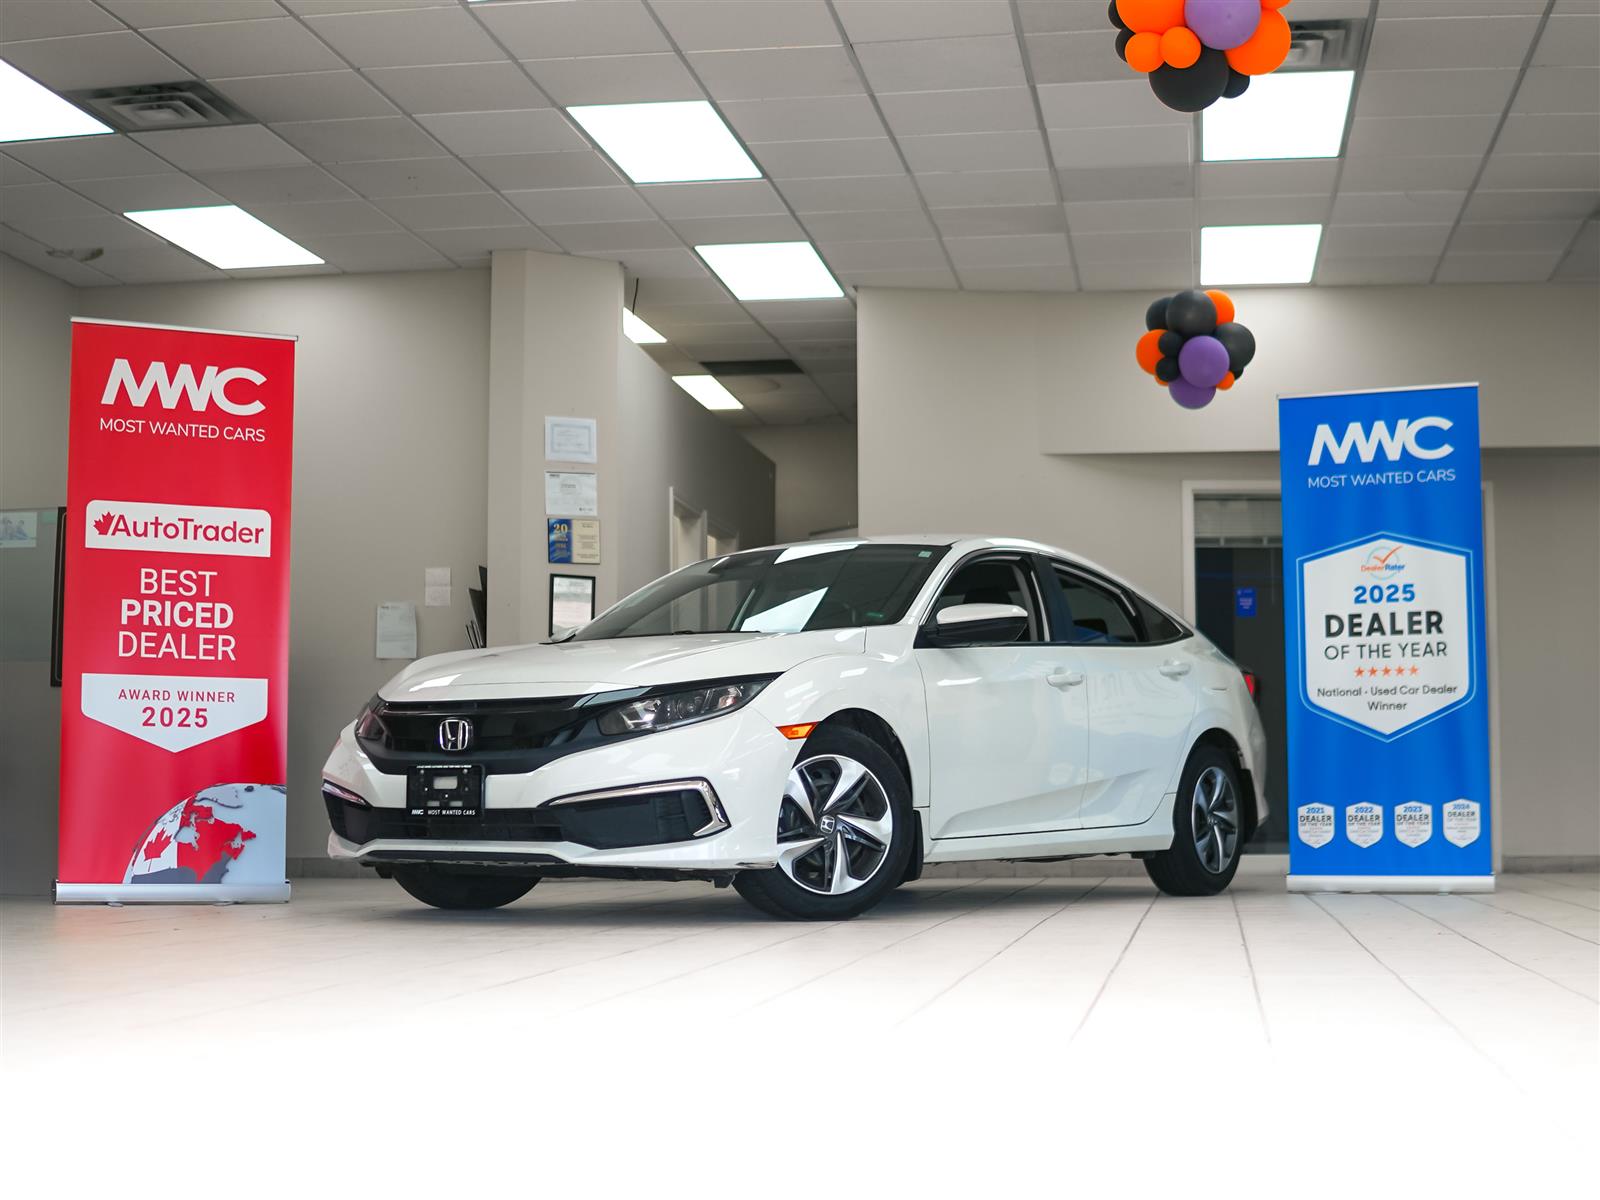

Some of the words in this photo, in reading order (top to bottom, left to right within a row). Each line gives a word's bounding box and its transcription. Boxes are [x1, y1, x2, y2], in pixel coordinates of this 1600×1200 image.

[101, 358, 267, 416] MWC
[100, 418, 145, 433] MOST
[149, 421, 219, 439] WANTED
[223, 426, 265, 442] CARS
[1307, 416, 1455, 466] MWC
[1308, 475, 1347, 488] MOST
[1350, 471, 1413, 486] WANTED
[1417, 469, 1456, 483] CARS
[111, 514, 264, 543] AutoTrader
[140, 568, 217, 597] BEST
[1354, 584, 1415, 604] 2025
[121, 598, 234, 629] PRICED
[1325, 611, 1443, 638] DEALER
[118, 631, 236, 661] DEALER
[1324, 645, 1350, 660] OF
[1357, 643, 1391, 659] THE
[1398, 642, 1447, 658] YEAR
[118, 689, 171, 701] AWARD
[177, 690, 236, 703] WINNER
[1317, 687, 1362, 697] National
[1370, 686, 1397, 696] Used
[1399, 685, 1419, 695] Car
[1422, 684, 1458, 694] Dealer
[142, 706, 208, 728] 2025
[1367, 701, 1408, 711] Winner
[1347, 814, 1380, 822] DEALER
